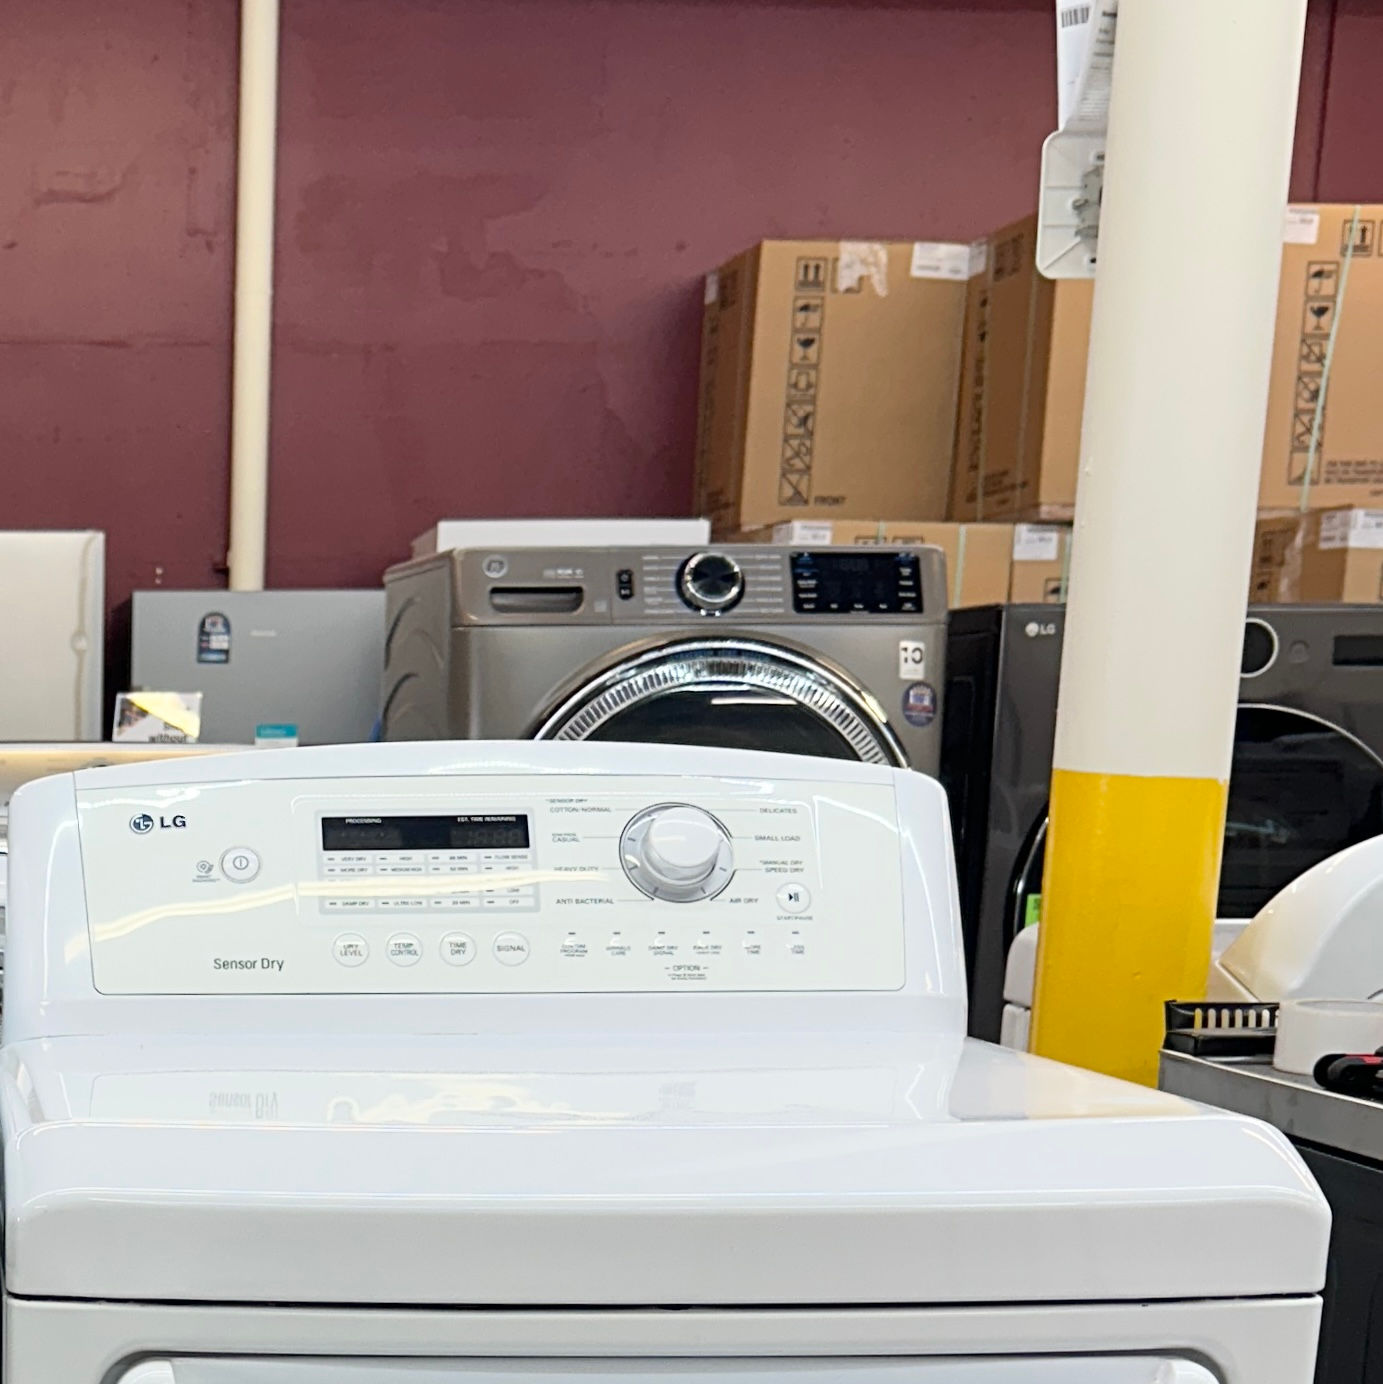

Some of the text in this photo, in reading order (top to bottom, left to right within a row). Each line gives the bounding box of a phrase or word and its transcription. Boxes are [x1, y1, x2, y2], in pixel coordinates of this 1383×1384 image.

[159, 814, 188, 829] LG
[390, 949, 419, 957] CONTROL
[213, 957, 285, 972] Sensor Dry
